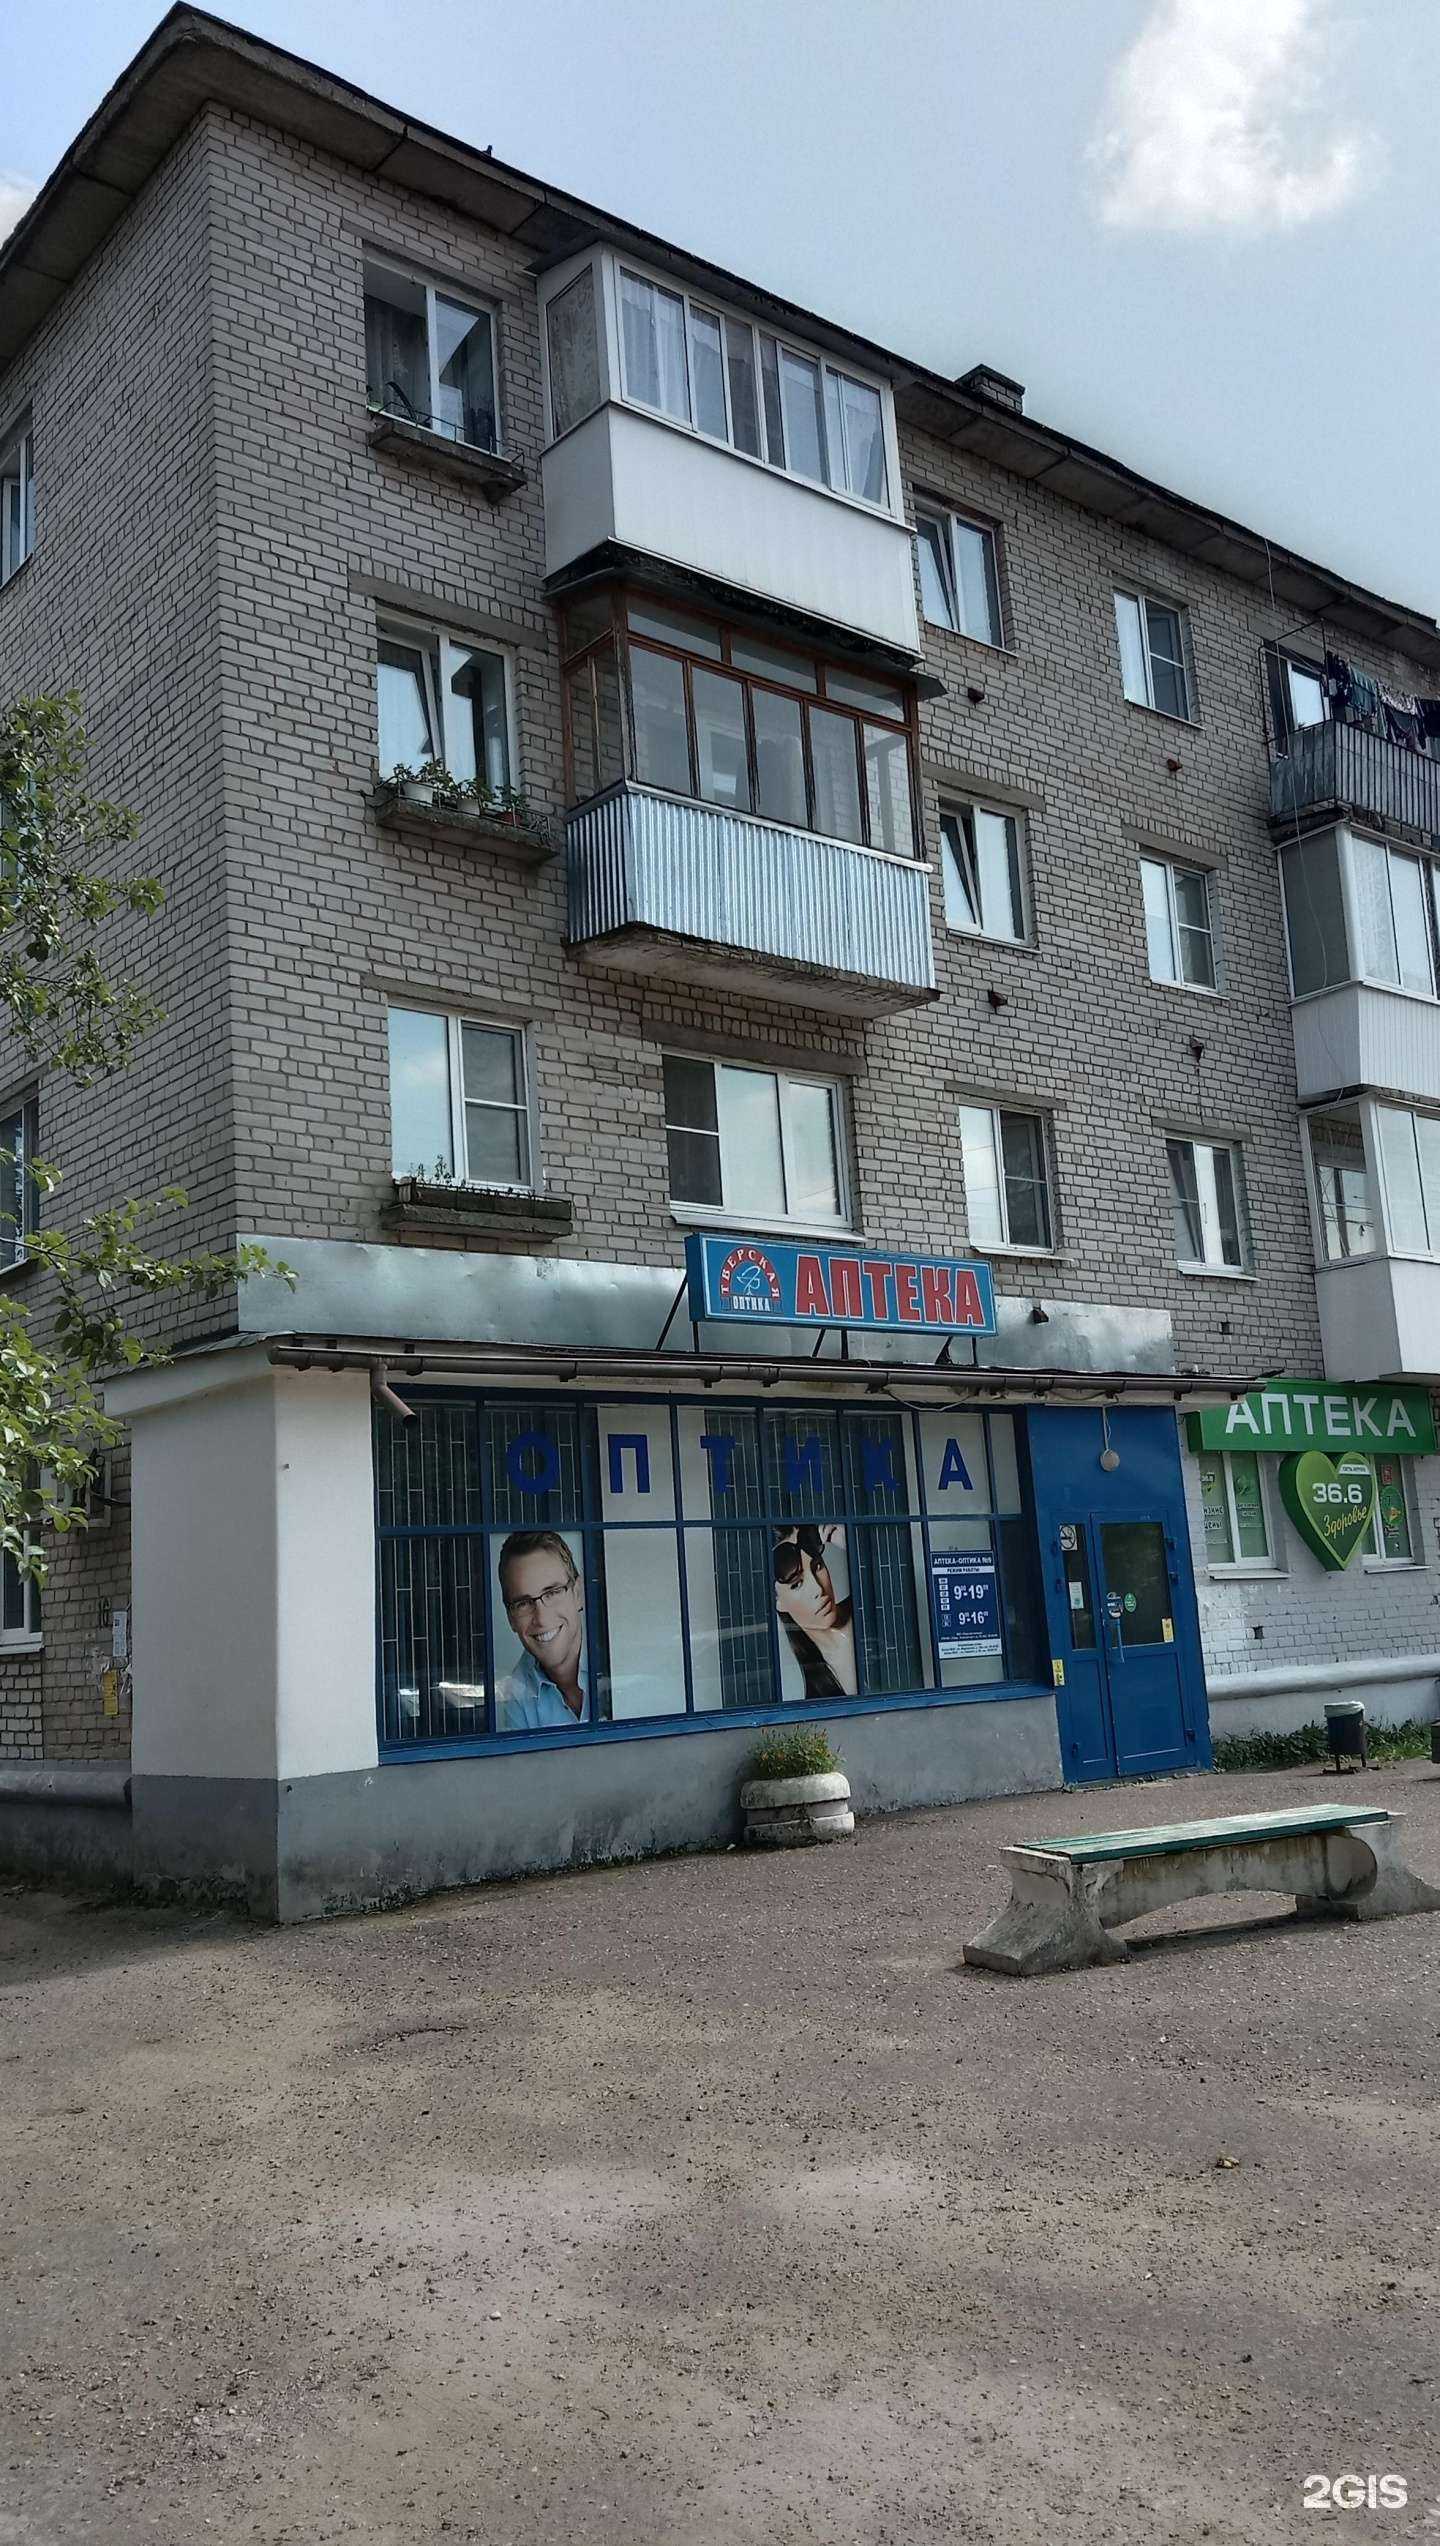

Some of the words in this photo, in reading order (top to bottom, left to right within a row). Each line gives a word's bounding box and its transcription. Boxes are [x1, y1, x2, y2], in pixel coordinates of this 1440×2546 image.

[720, 1248, 781, 1298] ТВЕРСКАЯ
[795, 1254, 986, 1327] АПТЕКА
[732, 1296, 771, 1312] ОПТИКА
[1225, 1393, 1417, 1438] АПТЕКА
[505, 1429, 974, 1496] ОПТИКА
[1311, 1483, 1363, 1504] 36.6
[1323, 1505, 1367, 1539] Здоровье
